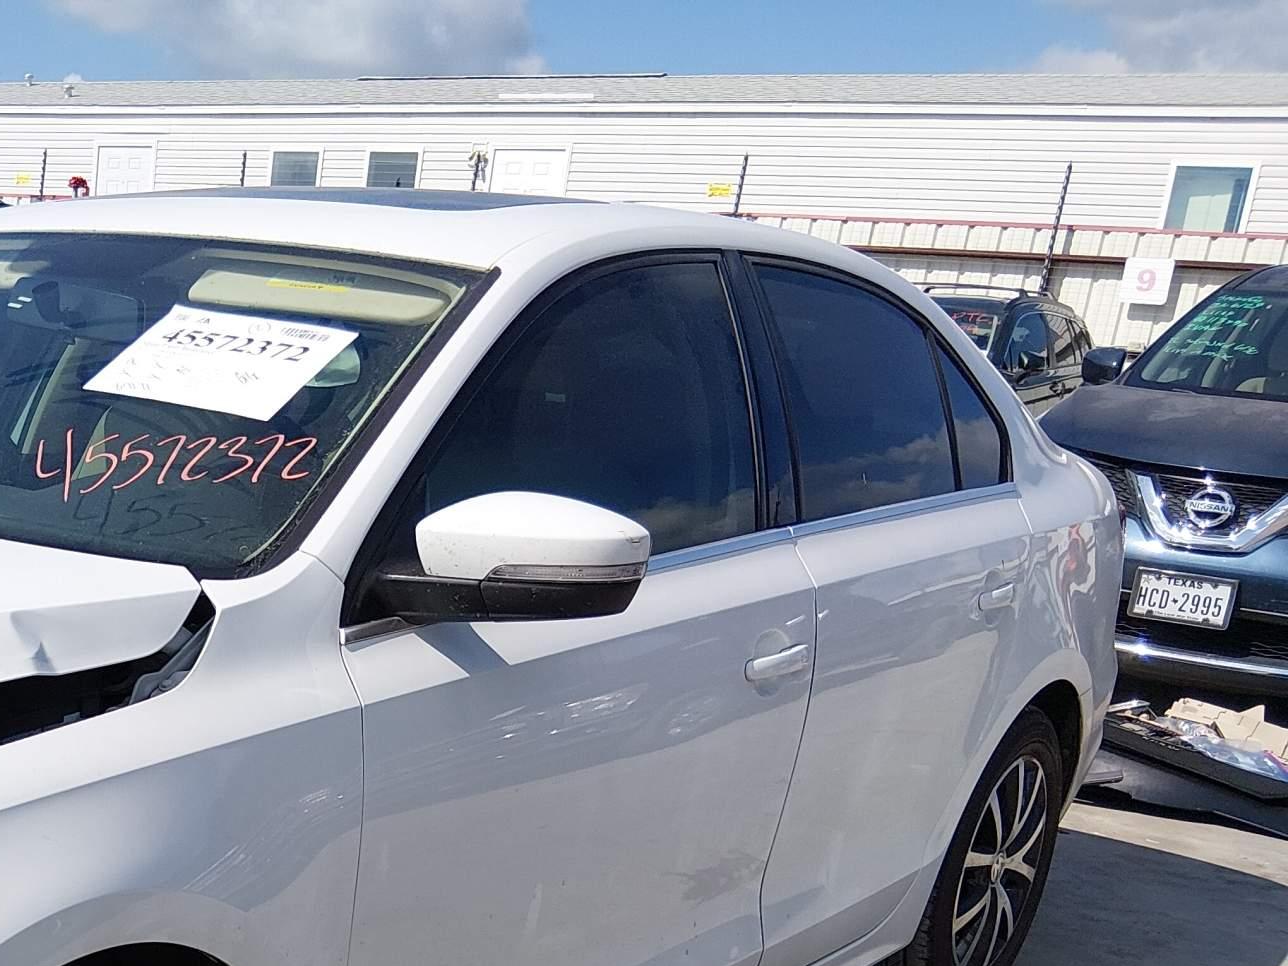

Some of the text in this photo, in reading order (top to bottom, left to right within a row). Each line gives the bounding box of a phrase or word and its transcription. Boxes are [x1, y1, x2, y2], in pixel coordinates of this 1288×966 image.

[1136, 268, 1157, 292] 9
[162, 327, 311, 363] 45572372
[35, 427, 318, 503] 45572372
[1189, 501, 1230, 512] NISSAN
[1167, 577, 1204, 590] TEXAS
[1136, 586, 1224, 618] HCD 2995
